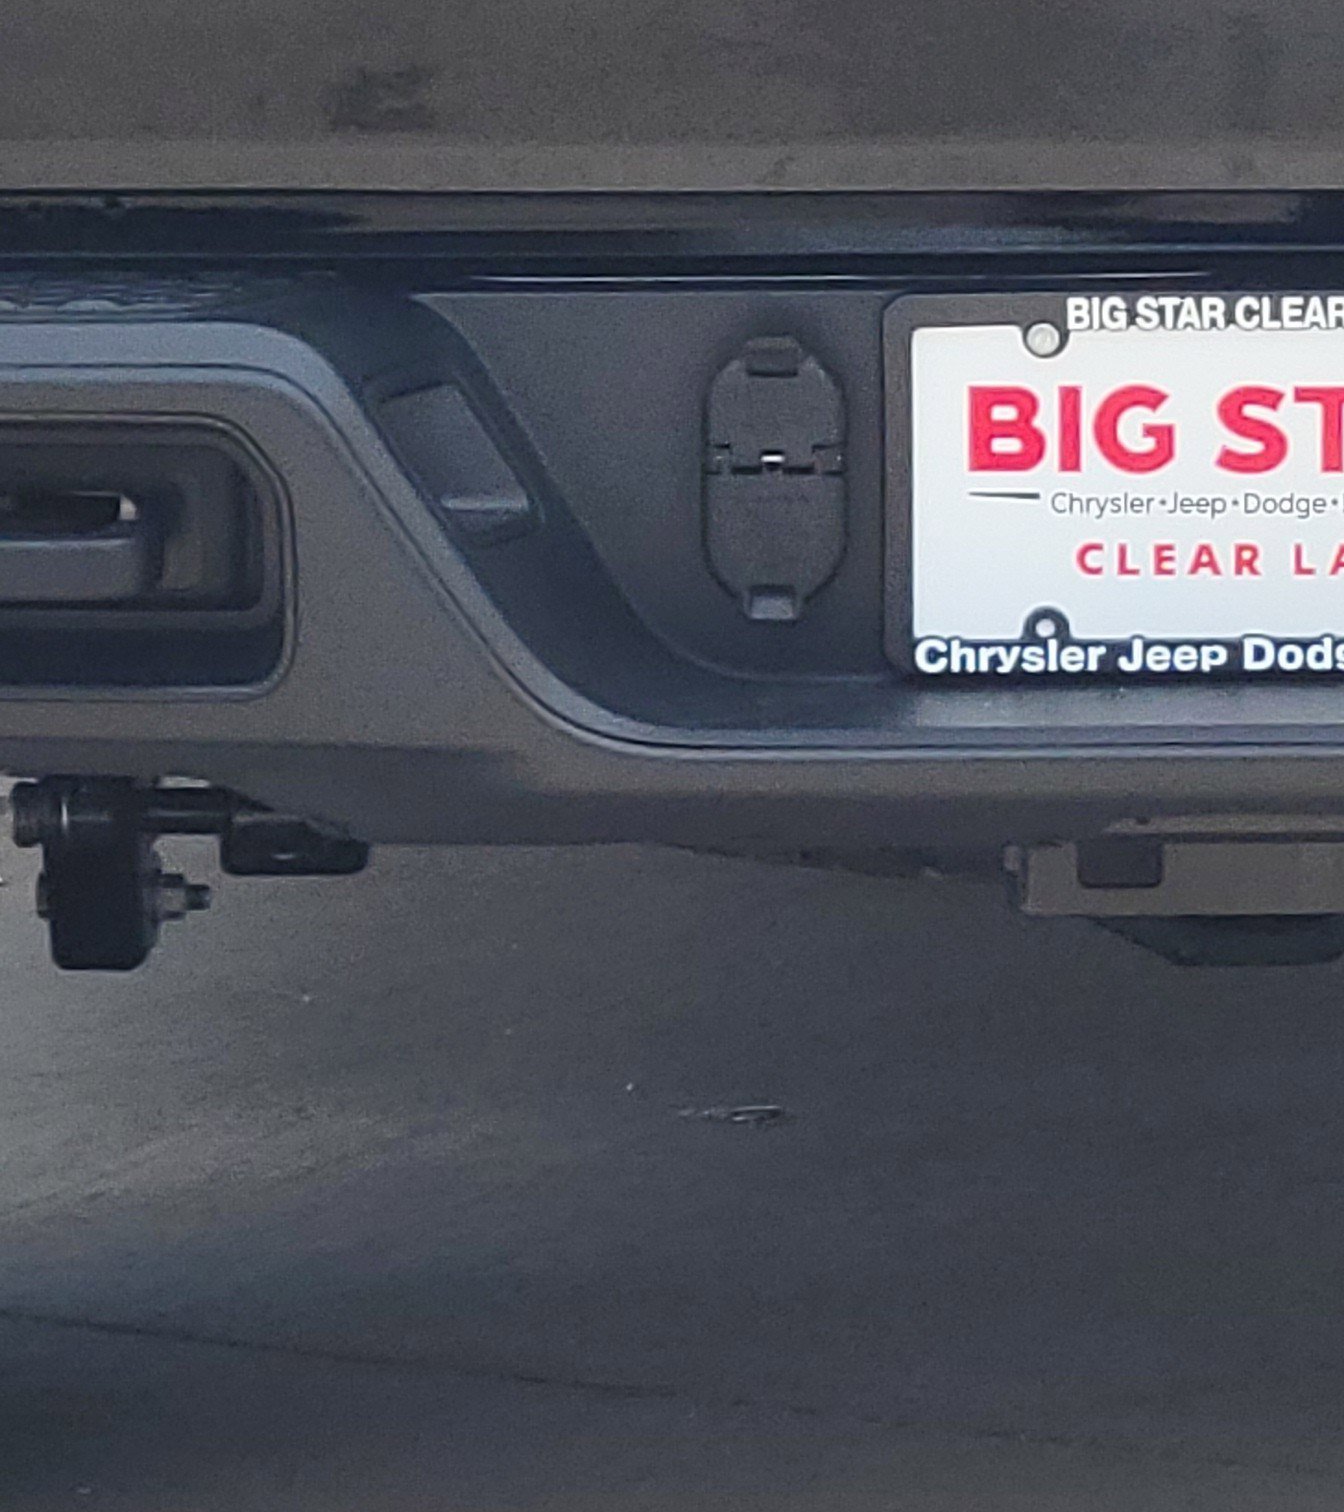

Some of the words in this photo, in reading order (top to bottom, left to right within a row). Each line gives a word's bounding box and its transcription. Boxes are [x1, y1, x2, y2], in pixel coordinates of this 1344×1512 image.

[1066, 297, 1127, 331] BIG
[1135, 297, 1226, 330] STAR
[966, 385, 1176, 473] BIG
[1076, 543, 1262, 576] CLEAR
[914, 638, 1107, 674] Chrysler
[1117, 638, 1228, 672] Jeep
